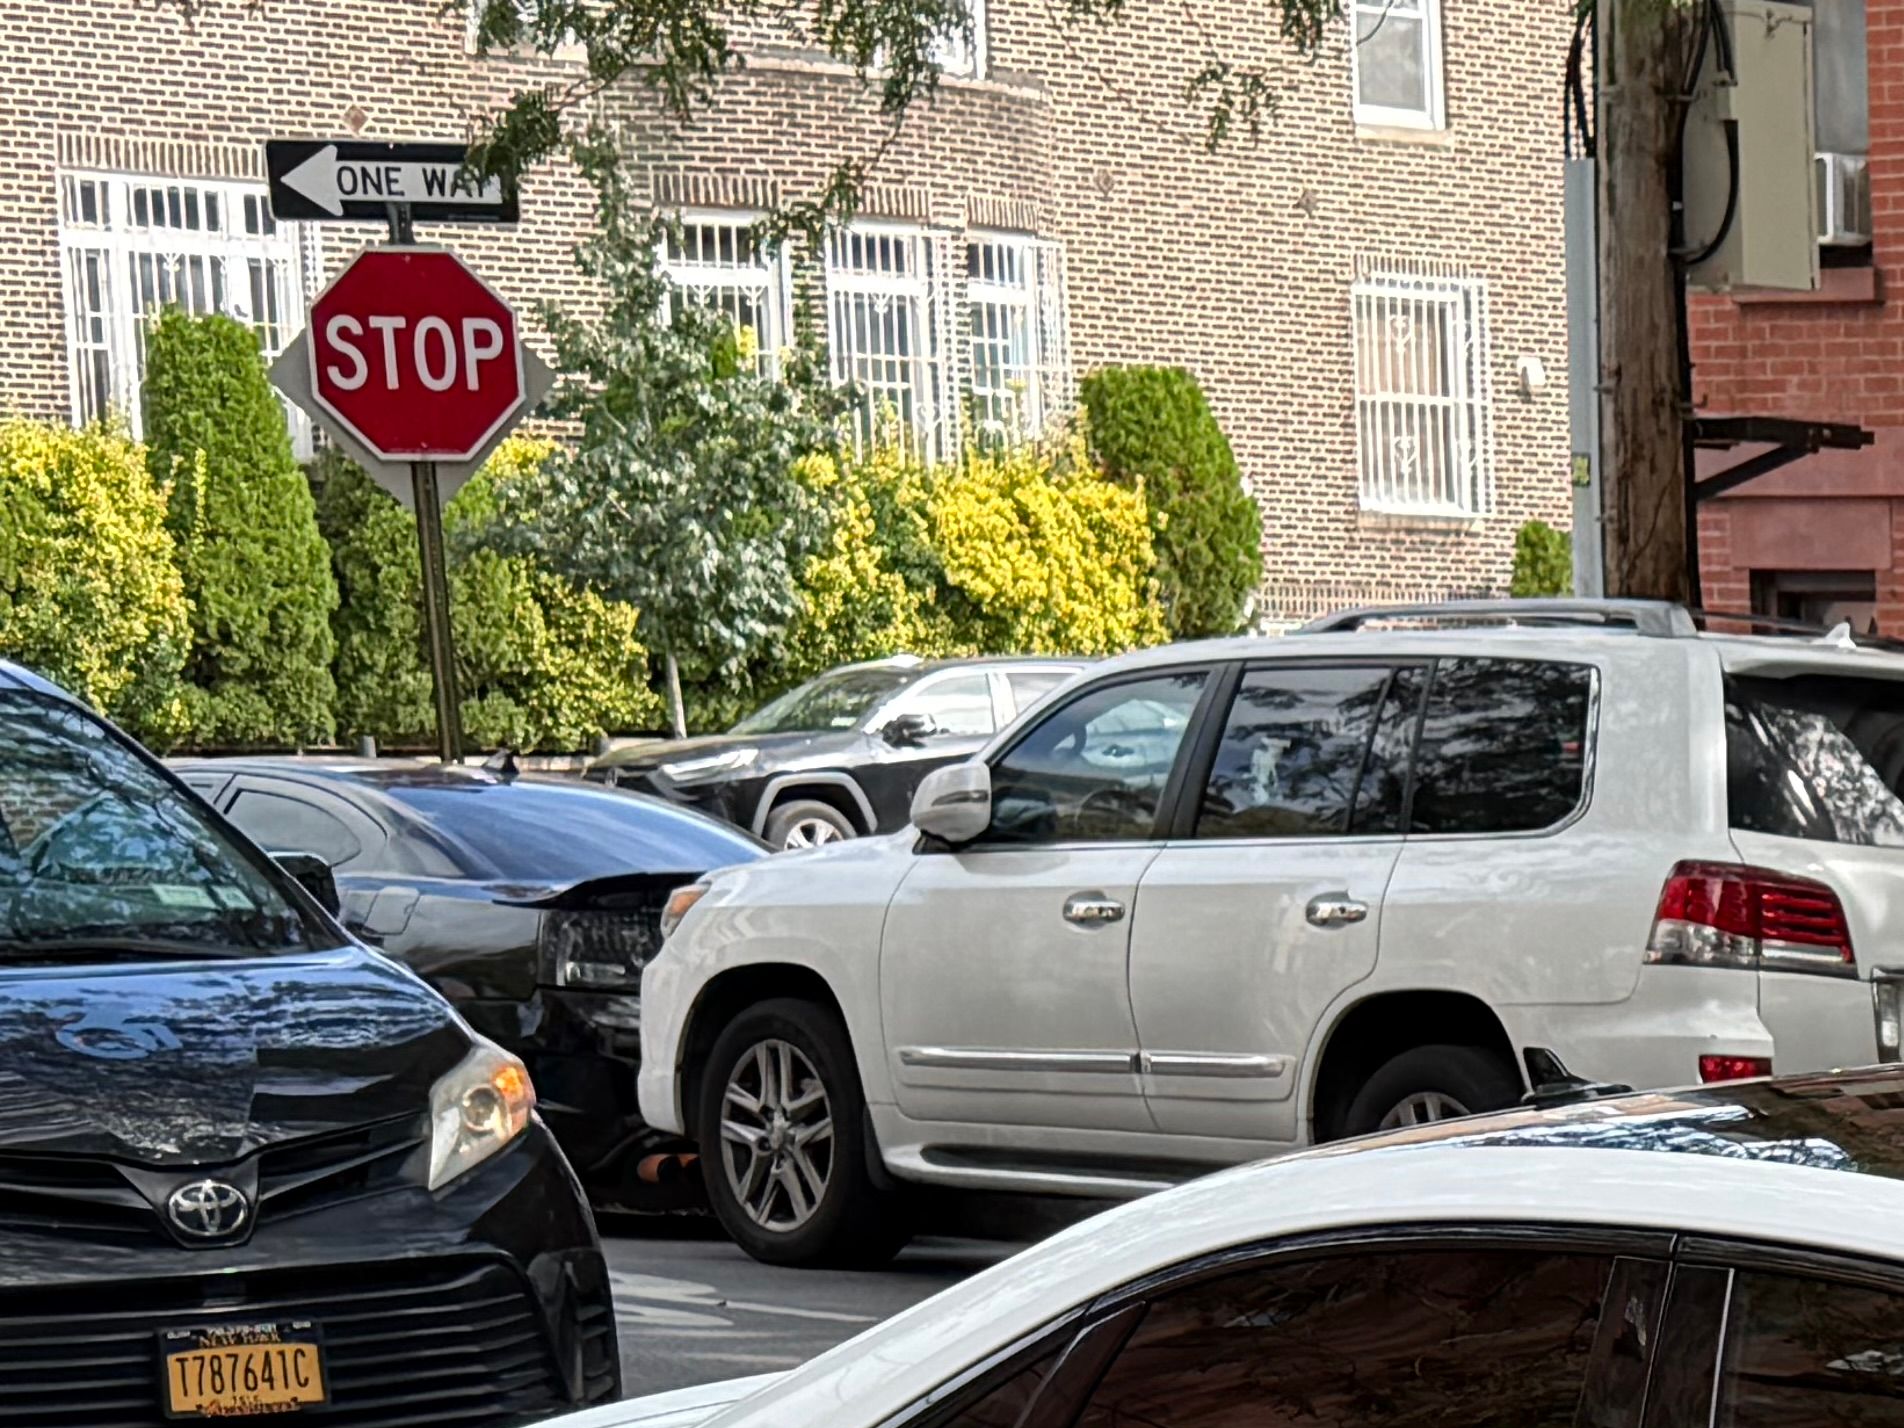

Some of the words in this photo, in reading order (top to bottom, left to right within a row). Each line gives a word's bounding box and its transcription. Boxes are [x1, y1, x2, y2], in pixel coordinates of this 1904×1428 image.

[337, 165, 405, 197] ONE
[325, 314, 504, 392] STOP
[175, 1349, 310, 1398] T787641C
